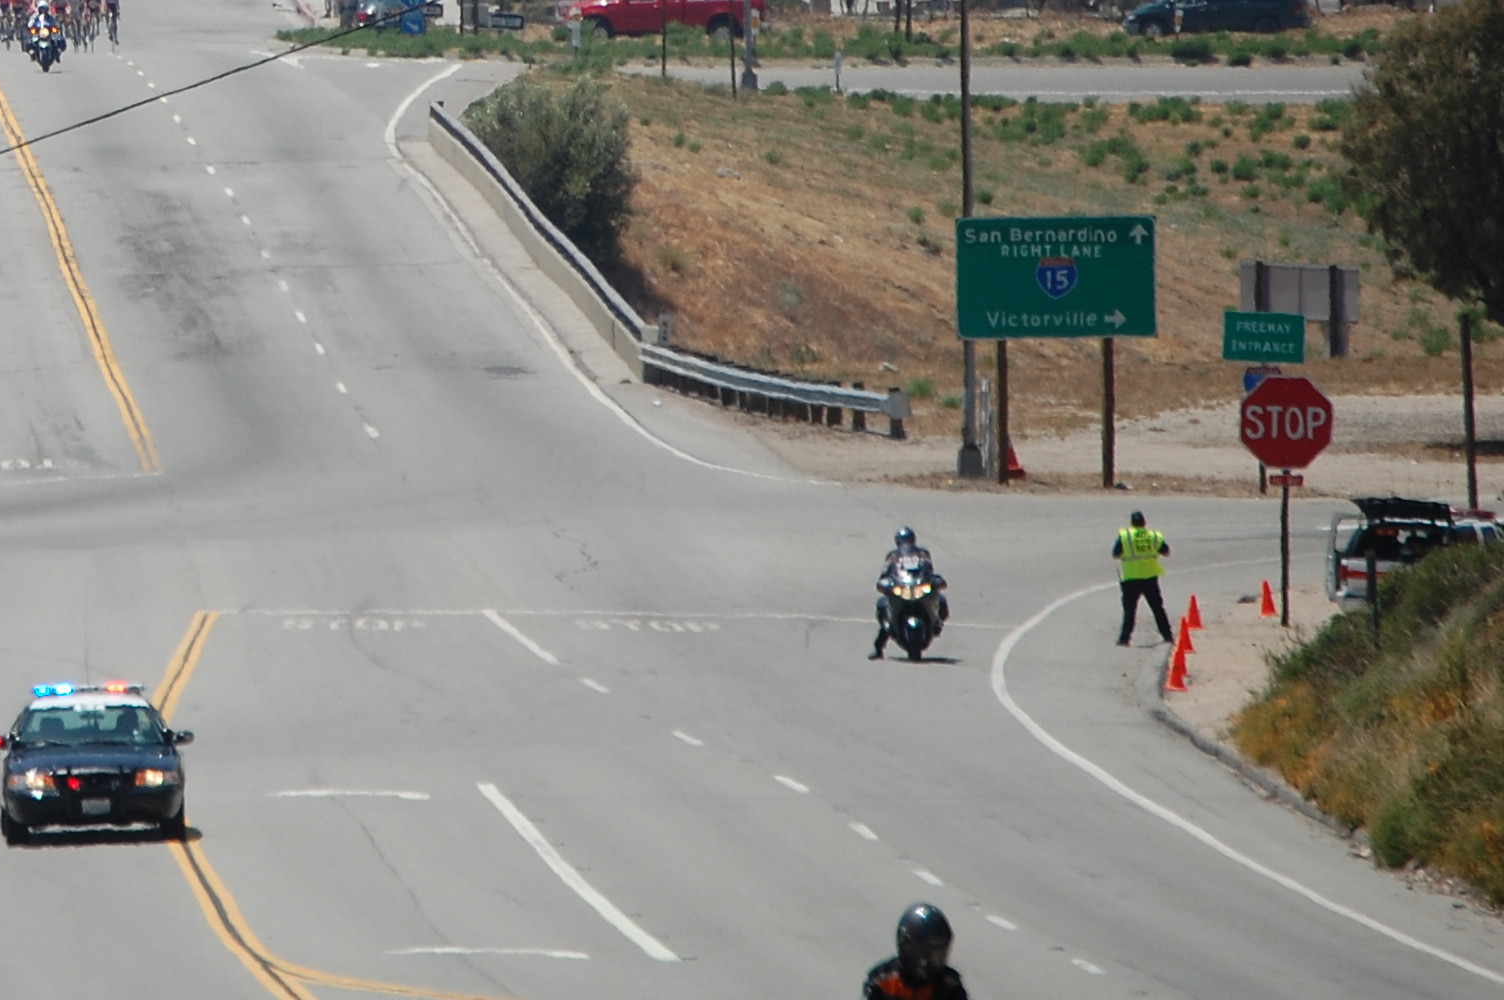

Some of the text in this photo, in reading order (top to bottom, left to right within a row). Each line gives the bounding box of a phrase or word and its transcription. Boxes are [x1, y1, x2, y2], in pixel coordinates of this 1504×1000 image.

[965, 226, 1118, 244] San Bernardino
[1000, 244, 1102, 258] RIGHT LANE
[1046, 269, 1069, 290] 15
[986, 310, 1098, 329] Victorville
[1236, 321, 1292, 335] FREEWAY
[1232, 339, 1296, 355] ENTRANCE
[1246, 405, 1327, 440] STOP
